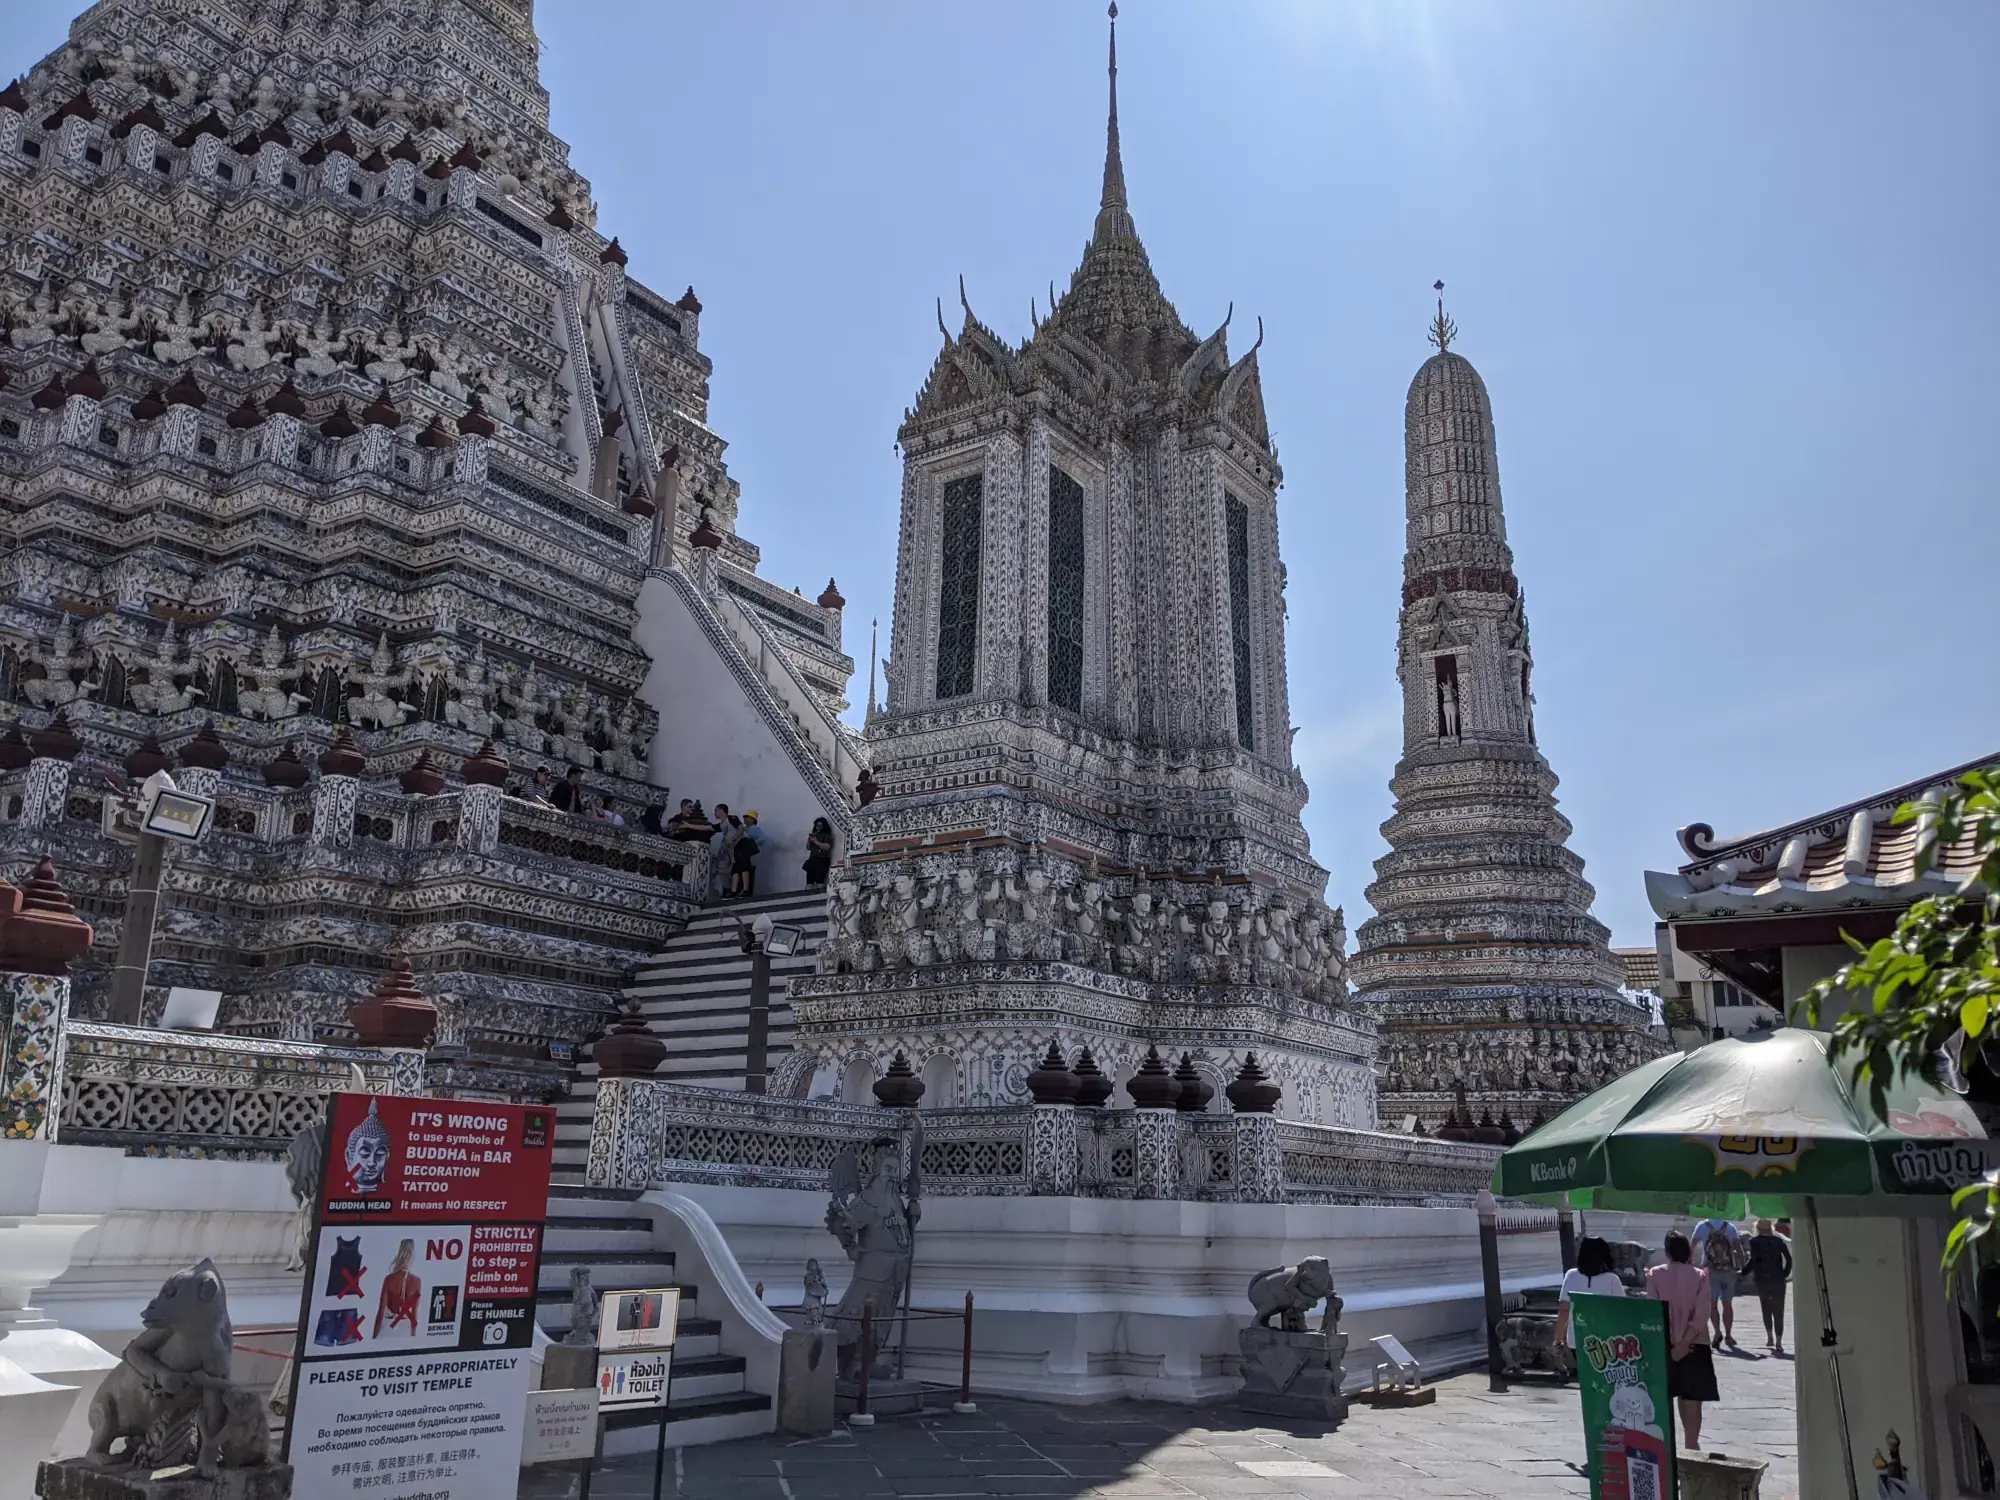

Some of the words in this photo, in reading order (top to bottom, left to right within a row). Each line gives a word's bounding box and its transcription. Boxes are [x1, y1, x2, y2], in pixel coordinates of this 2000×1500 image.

[410, 1112, 443, 1128] IT'S
[448, 1114, 508, 1131] WRONG
[408, 1131, 420, 1141] to
[423, 1133, 443, 1143] use
[446, 1133, 491, 1146] symbols
[493, 1135, 505, 1146] of
[406, 1147, 467, 1162] BUDDHA
[470, 1151, 481, 1162] in
[483, 1150, 512, 1164] BAR
[404, 1165, 480, 1178] DECORATION
[1531, 1157, 1567, 1182] KBank
[1895, 1143, 1984, 1185] ทำบุญ
[402, 1181, 449, 1193] TATTOO
[329, 1202, 366, 1210] BUDDHA
[367, 1202, 391, 1210] HEAD
[411, 1202, 443, 1210] means
[446, 1200, 461, 1210] NO
[463, 1201, 507, 1211] RESPECT
[474, 1227, 536, 1240] STRICTLY
[425, 1238, 463, 1260] NO
[473, 1243, 533, 1253] PROHIBITED
[472, 1256, 486, 1267] to
[489, 1256, 517, 1269] step
[470, 1271, 501, 1283] climb
[504, 1273, 518, 1281] on
[469, 1285, 498, 1294] Buddha
[500, 1285, 528, 1293] statues
[470, 1310, 484, 1319] BE
[486, 1309, 525, 1318] HUMBLE
[309, 1369, 364, 1384] PLEASE
[368, 1366, 413, 1380] DRESS
[416, 1358, 518, 1376] APPROPRIATELY
[630, 1356, 665, 1378] ห้องน้ำ
[360, 1384, 378, 1397] TO
[383, 1381, 419, 1396] VISIT
[423, 1377, 473, 1392] TEMPLE
[628, 1379, 665, 1393] TOILET
[336, 1409, 393, 1424] Пожалуйста
[396, 1404, 447, 1417] одевайтесь
[449, 1401, 486, 1413] опрятно.
[318, 1429, 331, 1439] Во
[333, 1426, 362, 1440] время
[365, 1420, 416, 1434] посещения
[418, 1414, 468, 1430] буддийских
[470, 1412, 501, 1424] храмов
[307, 1439, 367, 1454] необходимо
[369, 1433, 419, 1448] соблюдать
[421, 1428, 468, 1442] некоторые
[469, 1425, 506, 1437] правила.
